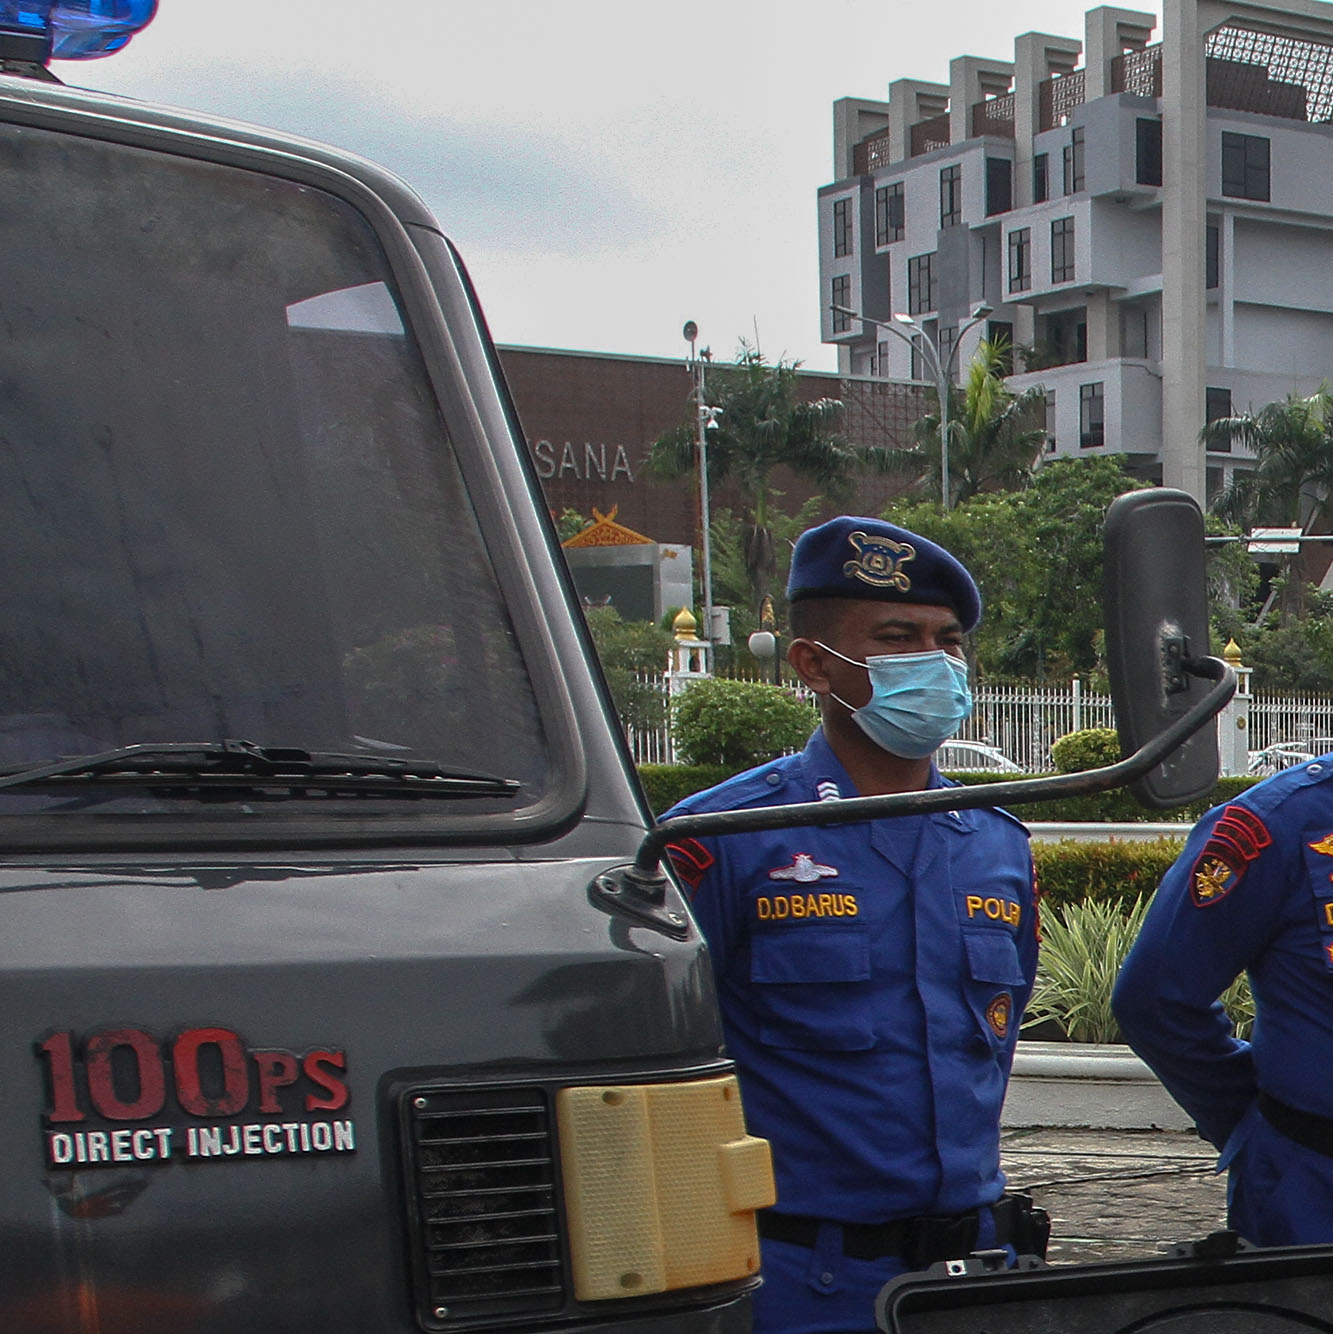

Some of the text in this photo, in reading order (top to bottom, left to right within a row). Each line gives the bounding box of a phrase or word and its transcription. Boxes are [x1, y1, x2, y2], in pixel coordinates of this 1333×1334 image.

[534, 439, 635, 482] SANA
[51, 1120, 356, 1164] DIRECT INJECTION
